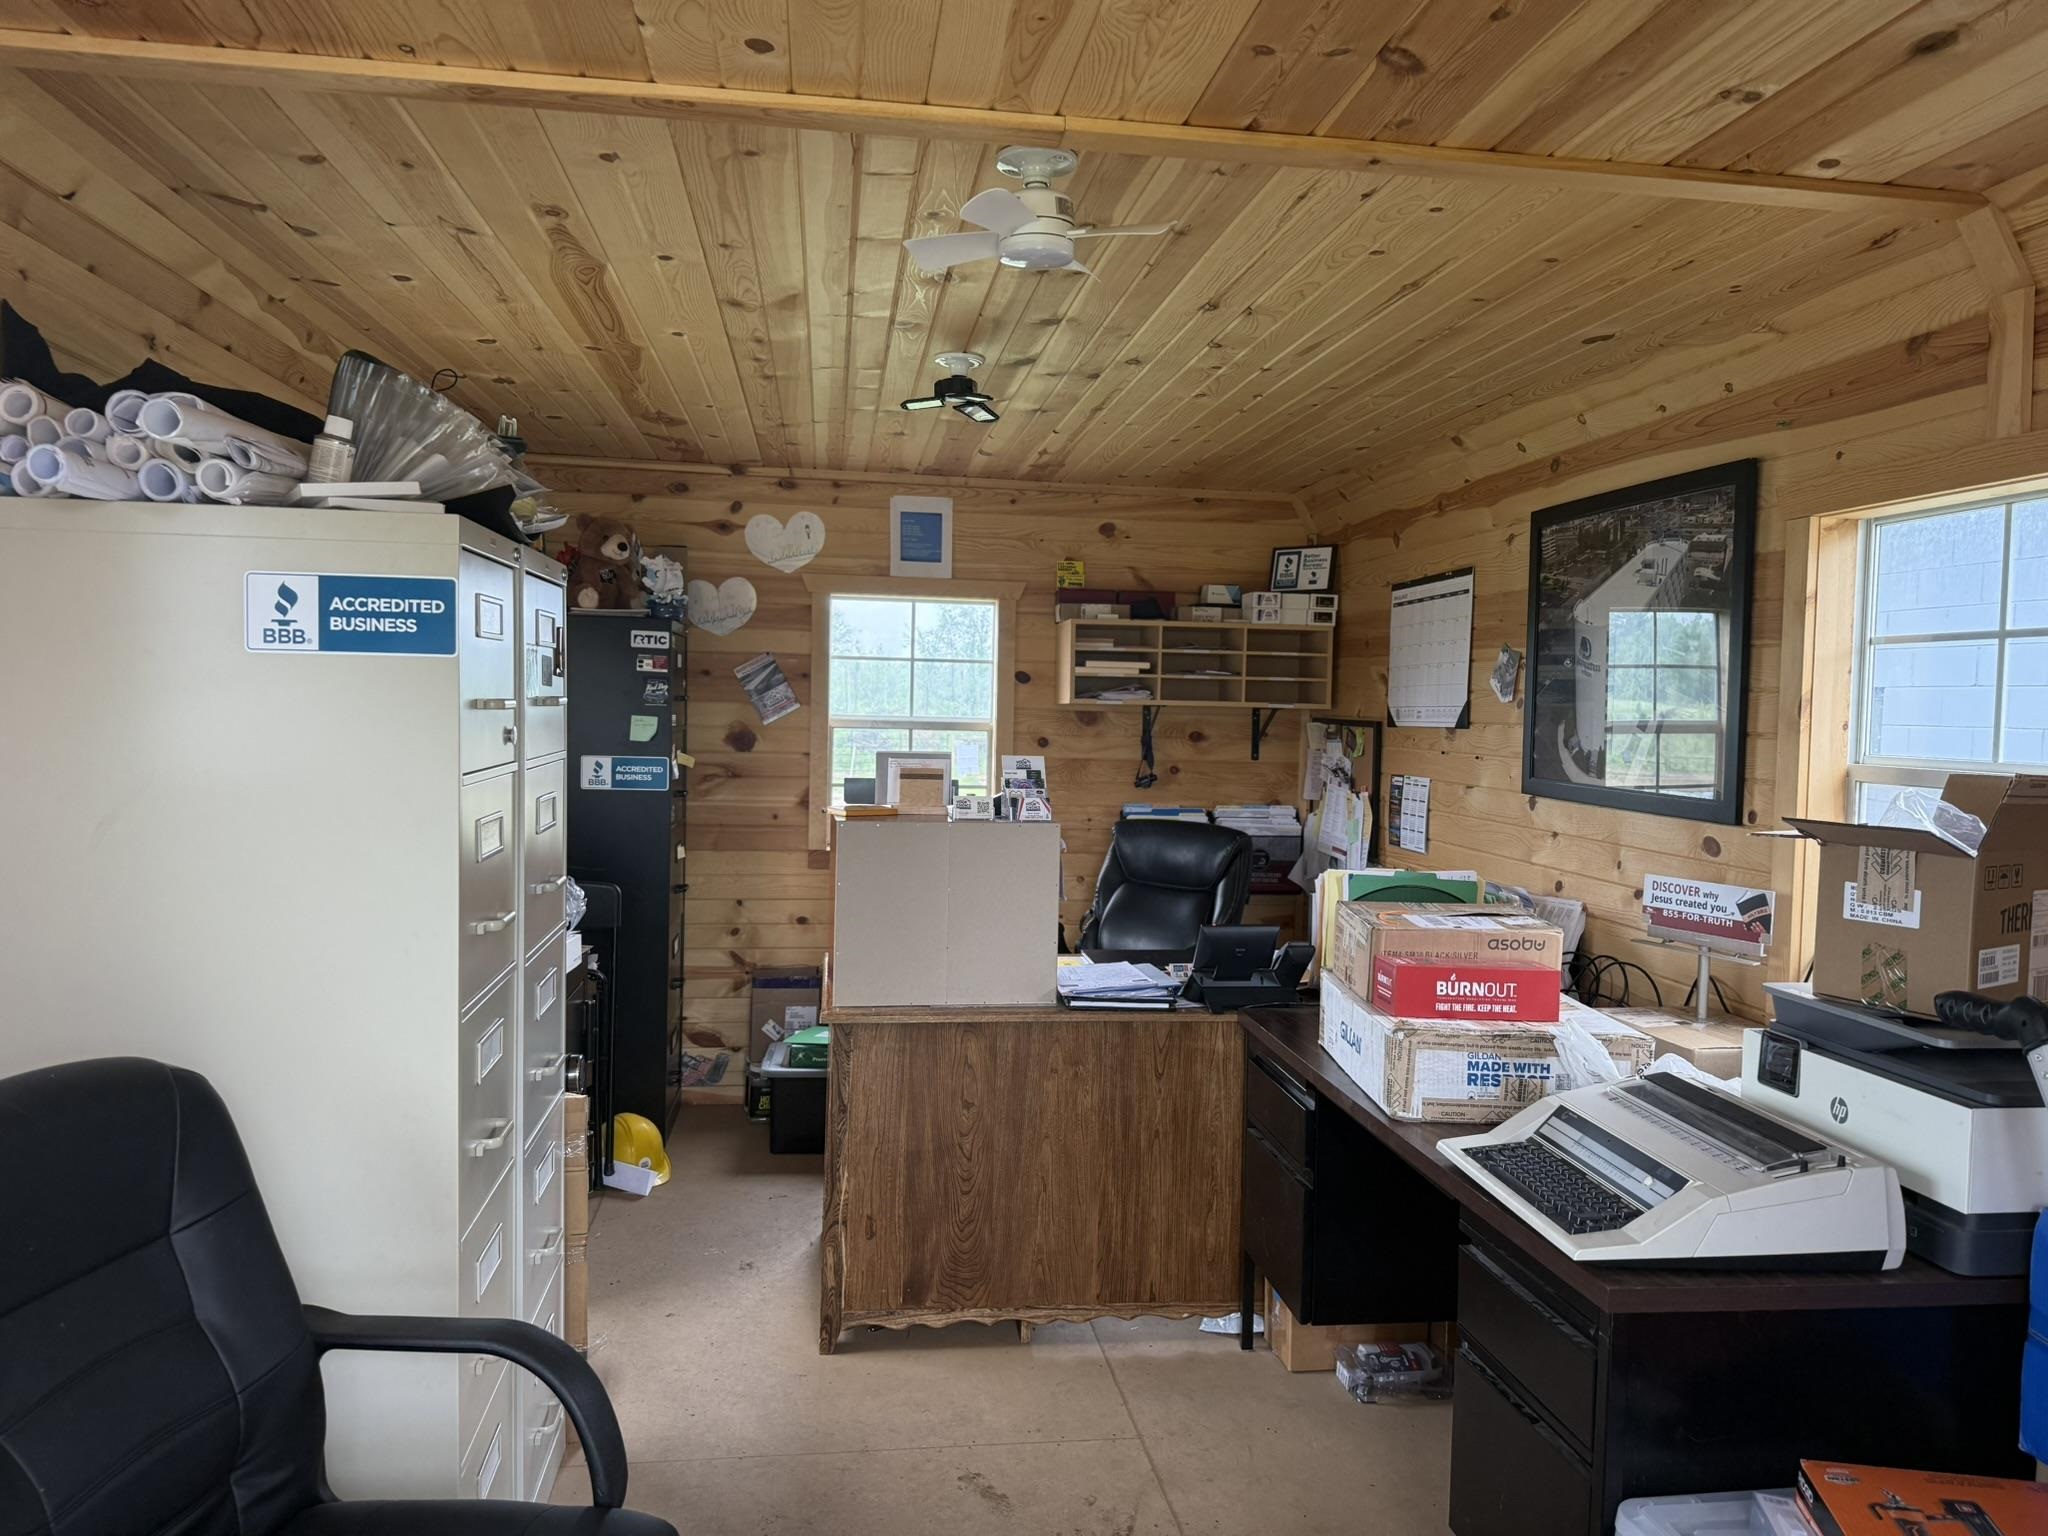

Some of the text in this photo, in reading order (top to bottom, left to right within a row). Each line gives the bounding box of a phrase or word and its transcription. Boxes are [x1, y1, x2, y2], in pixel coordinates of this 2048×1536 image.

[329, 597, 445, 615] ACCREDITED
[329, 616, 417, 633] BUSINESS
[263, 628, 306, 645] BBB
[633, 634, 668, 646] RTIC
[616, 765, 663, 773] ACCREDITED
[588, 778, 606, 786] BBB
[1652, 880, 1719, 902] DISCOVER why
[1650, 894, 1727, 914] Jesus created you
[1663, 909, 1733, 928] 855-FOR-TRUTH
[1488, 936, 1546, 951] asobu
[1436, 981, 1517, 997] BURNOUT
[1452, 1003, 1462, 1011] THE
[1463, 1004, 1476, 1012] FIRE.
[1478, 1004, 1491, 1012] KEEP
[1492, 1004, 1502, 1012] THE
[1502, 1005, 1517, 1013] HEAT.
[1468, 1052, 1501, 1060] GILDAN
[1467, 1060, 1550, 1074] MADE WITH
[1831, 1096, 1848, 1124] hp
